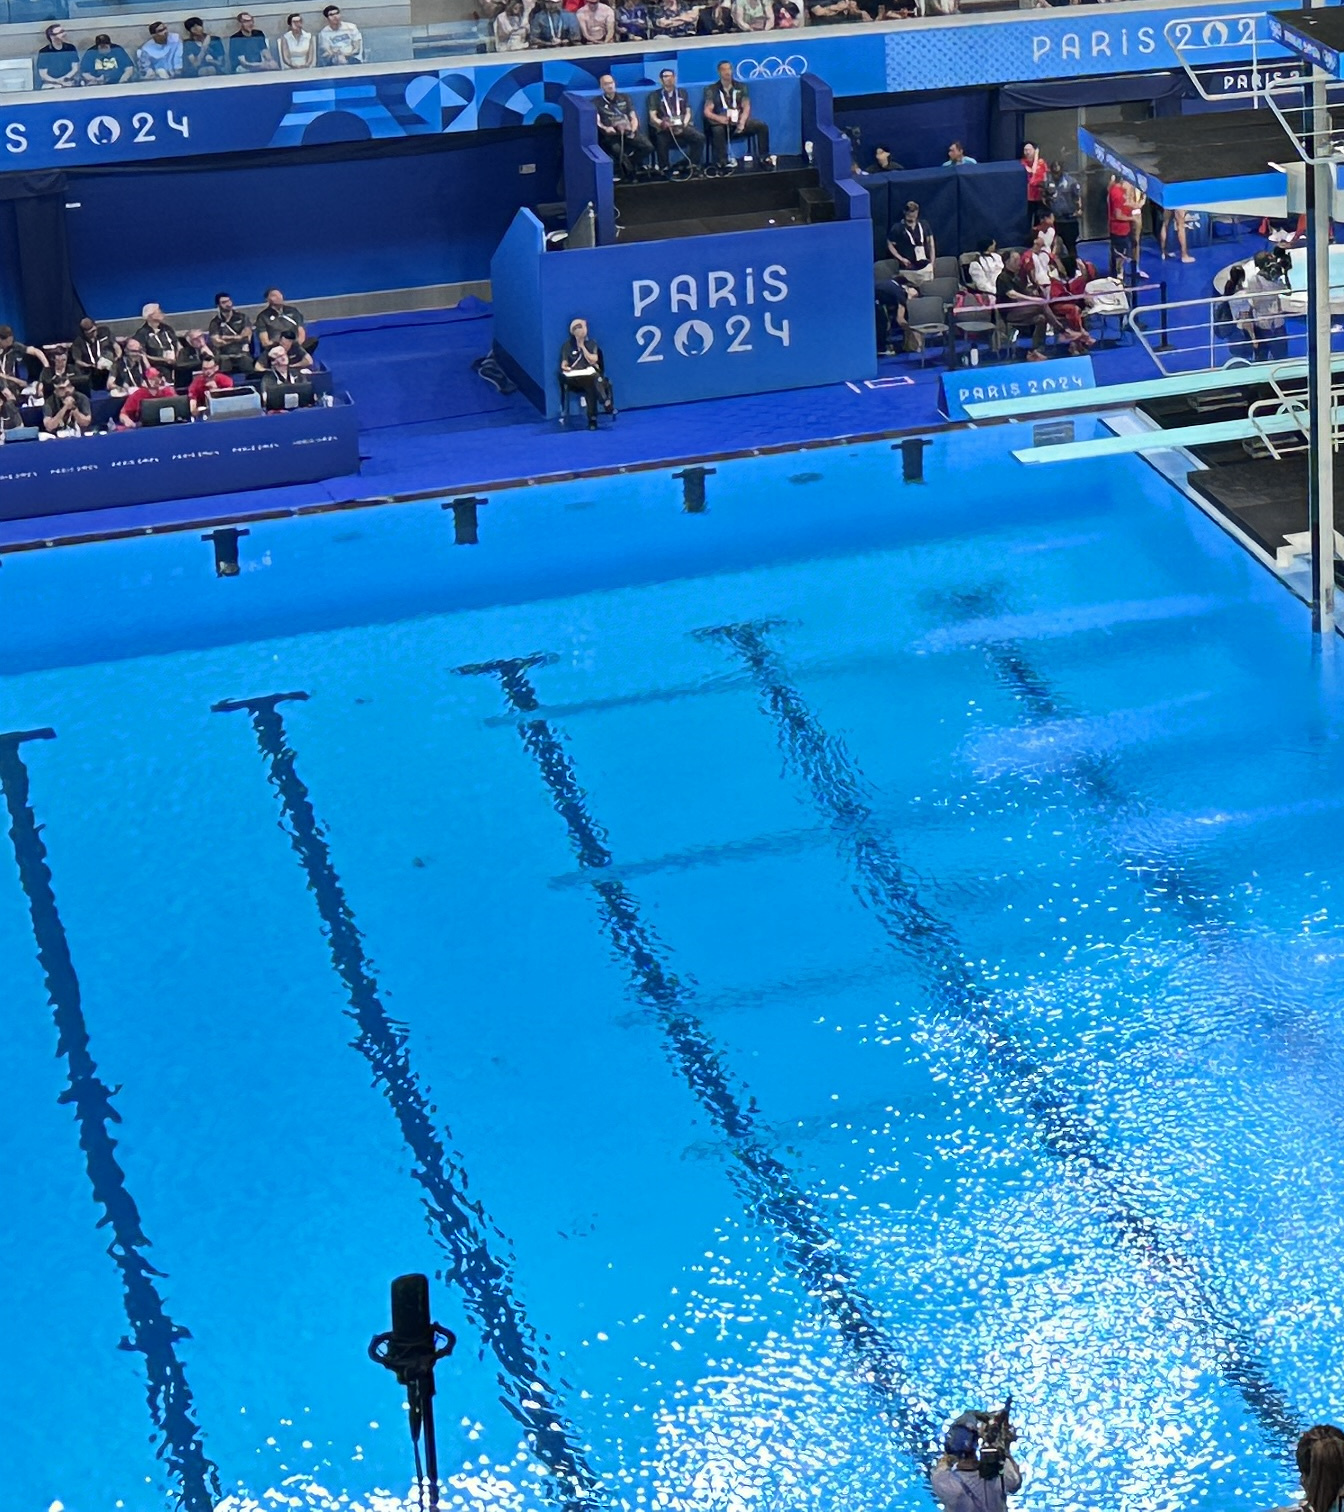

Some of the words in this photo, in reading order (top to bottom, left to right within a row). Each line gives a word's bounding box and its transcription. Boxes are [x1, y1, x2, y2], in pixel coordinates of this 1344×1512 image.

[1032, 28, 1155, 63] PARIS
[1175, 18, 1256, 49] 202
[52, 109, 189, 149] 2024
[632, 264, 788, 317] PARIS
[635, 311, 789, 363] 2024
[959, 382, 1021, 401] PARIS
